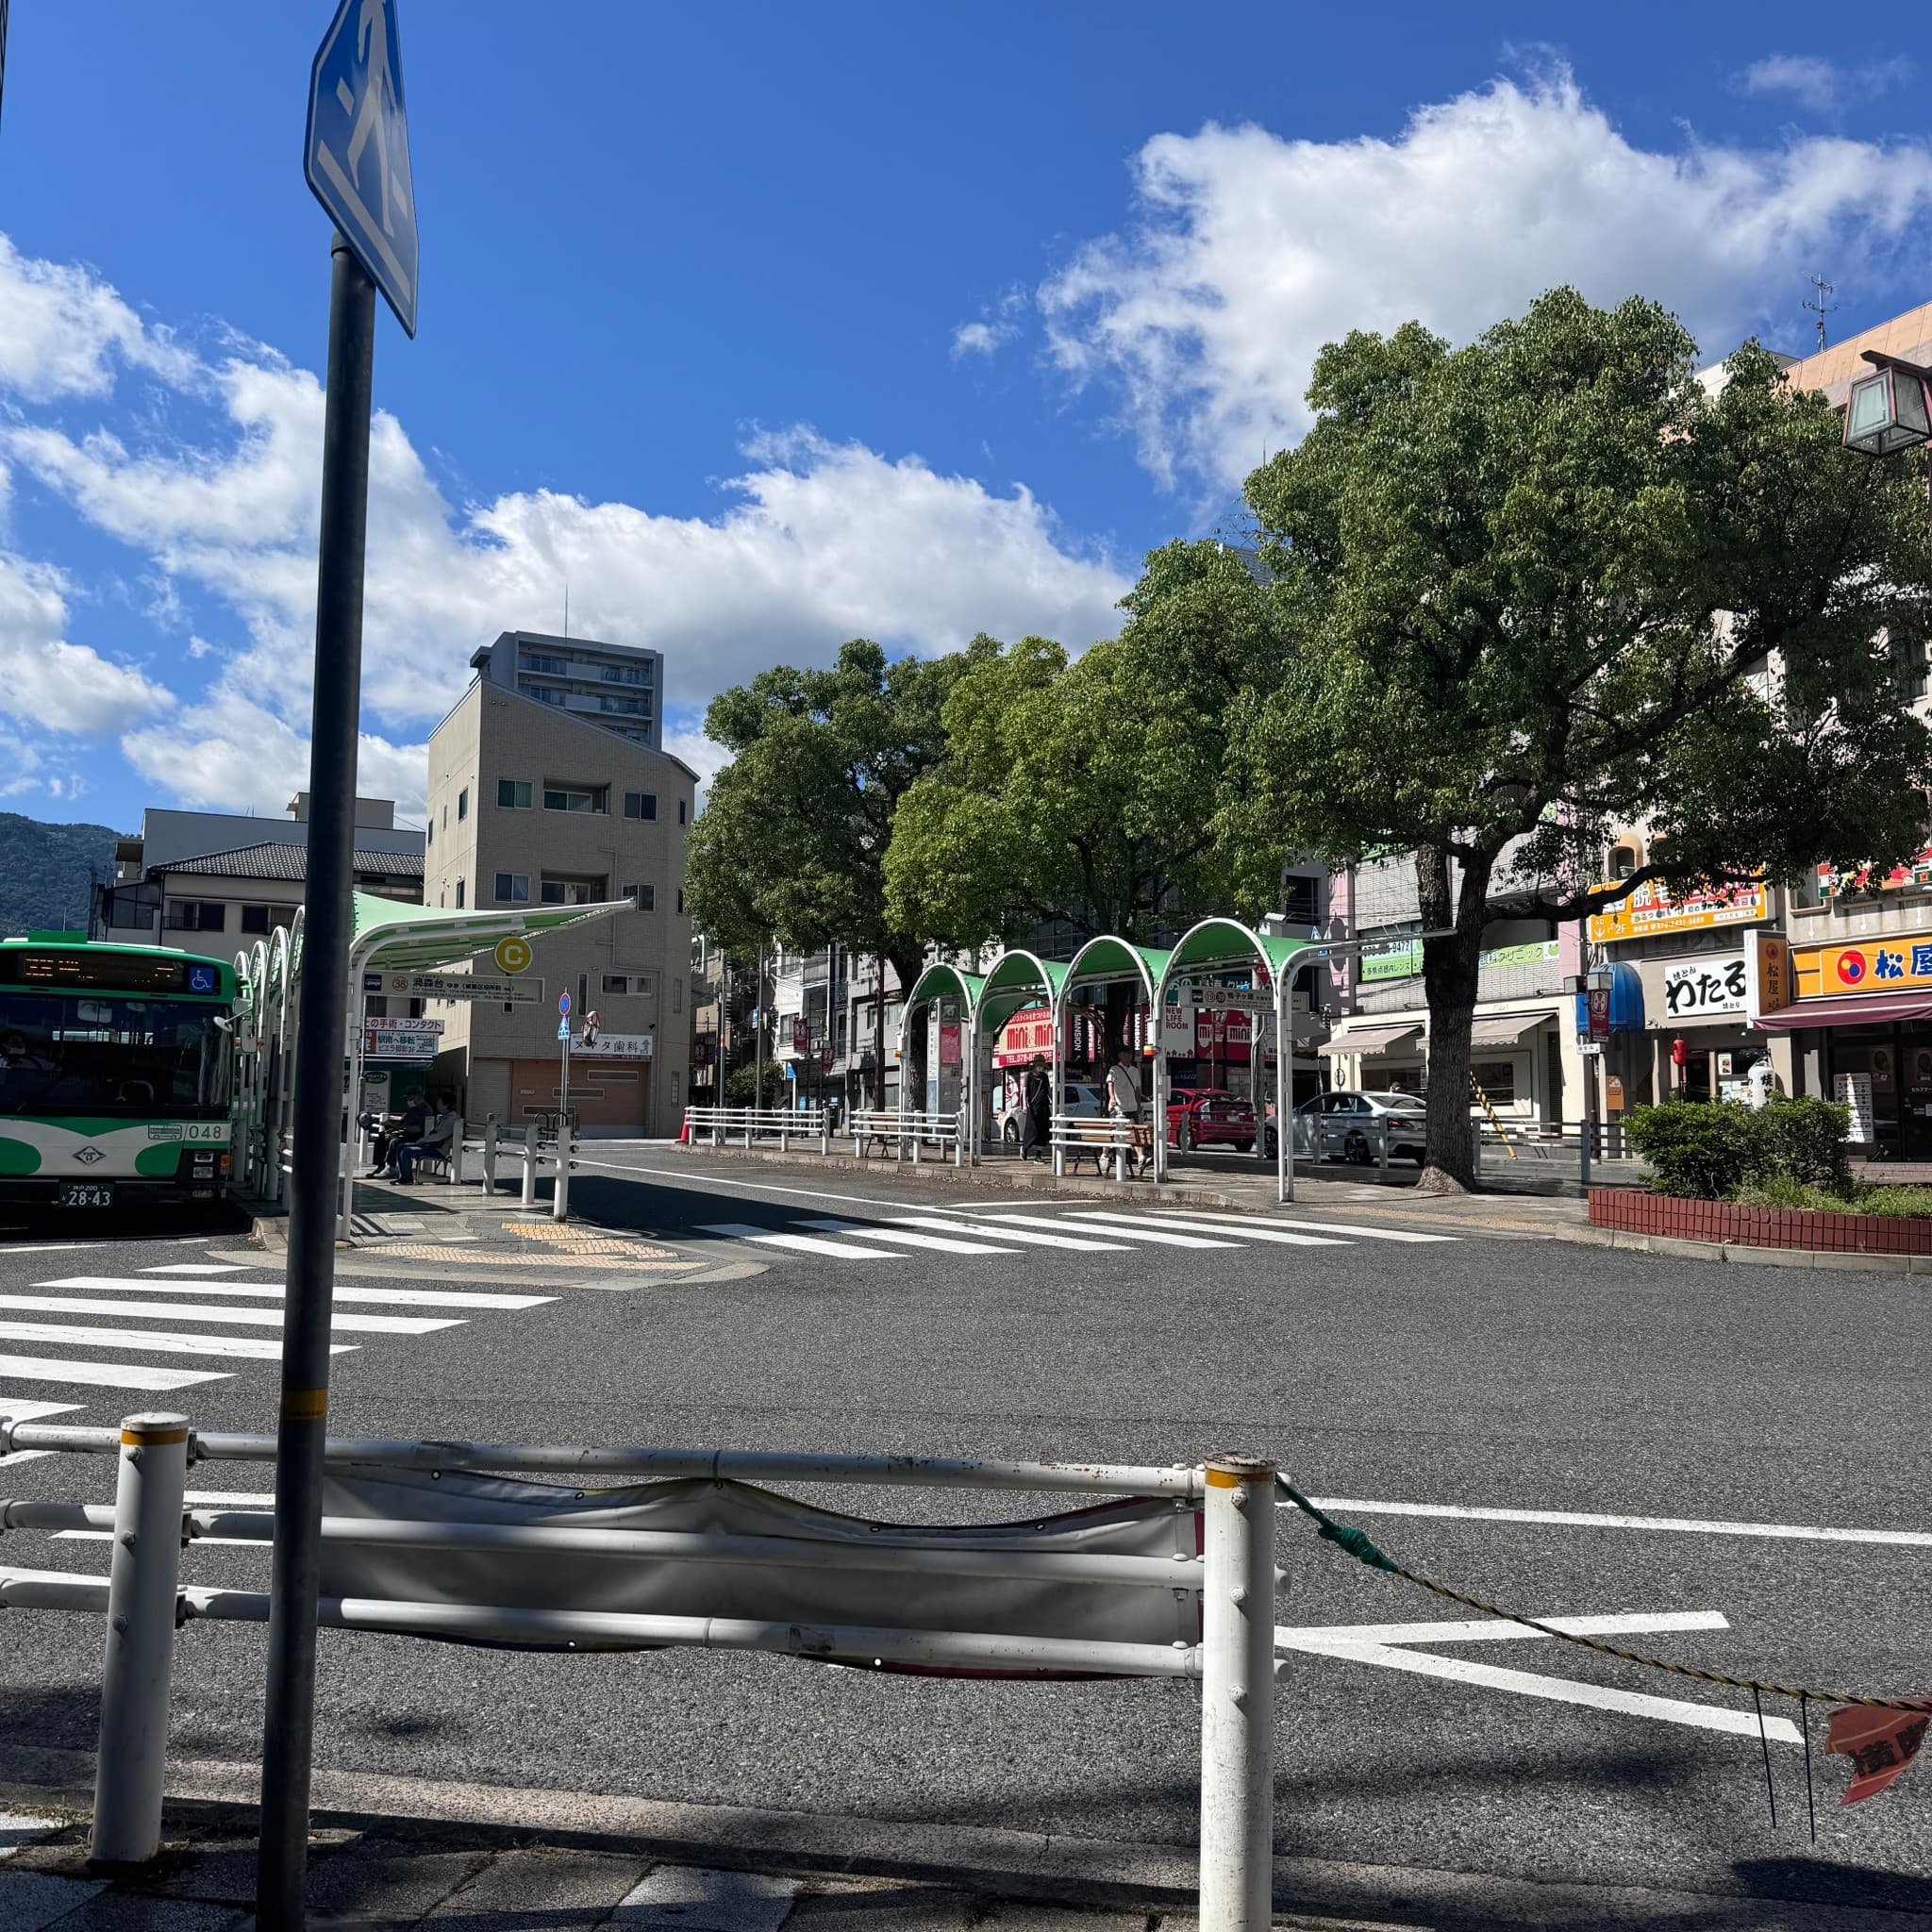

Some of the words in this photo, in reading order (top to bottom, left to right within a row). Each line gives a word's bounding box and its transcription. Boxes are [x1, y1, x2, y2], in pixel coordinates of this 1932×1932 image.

[1615, 924, 1627, 935] 2F
[505, 945, 524, 964] C
[1874, 943, 1932, 980] 松屋
[394, 977, 406, 989] 38
[1665, 960, 1746, 1014] わたる
[1007, 1026, 1028, 1051] mini
[1034, 1024, 1054, 1048] min
[1229, 1024, 1250, 1041] mini
[189, 1124, 222, 1140] 048
[69, 1191, 110, 1207] 28-43
